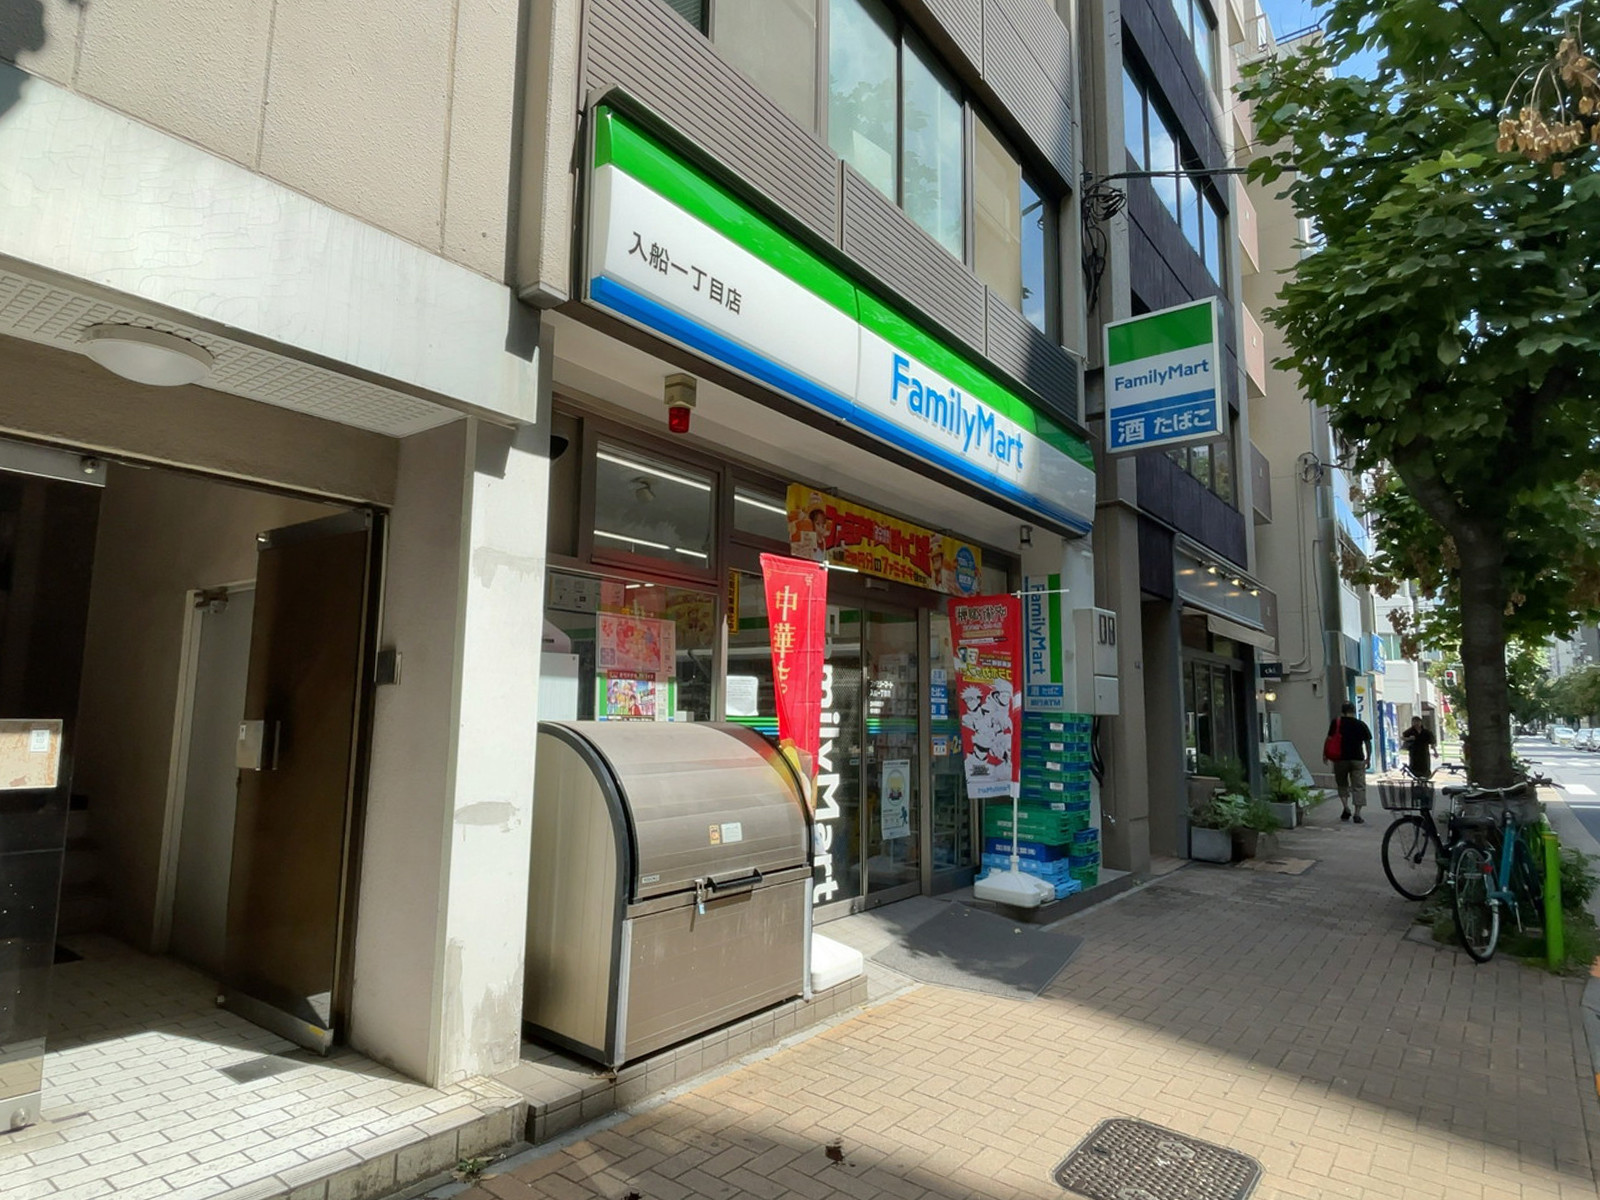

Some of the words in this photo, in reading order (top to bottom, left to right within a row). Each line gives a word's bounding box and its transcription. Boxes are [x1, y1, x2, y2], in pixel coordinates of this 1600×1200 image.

[628, 231, 742, 315] 入船一丁目店
[1114, 359, 1209, 391] FamilyMart
[891, 353, 1024, 469] FamilyMart
[1118, 418, 1145, 443] 酒
[1154, 408, 1211, 434] たばこ
